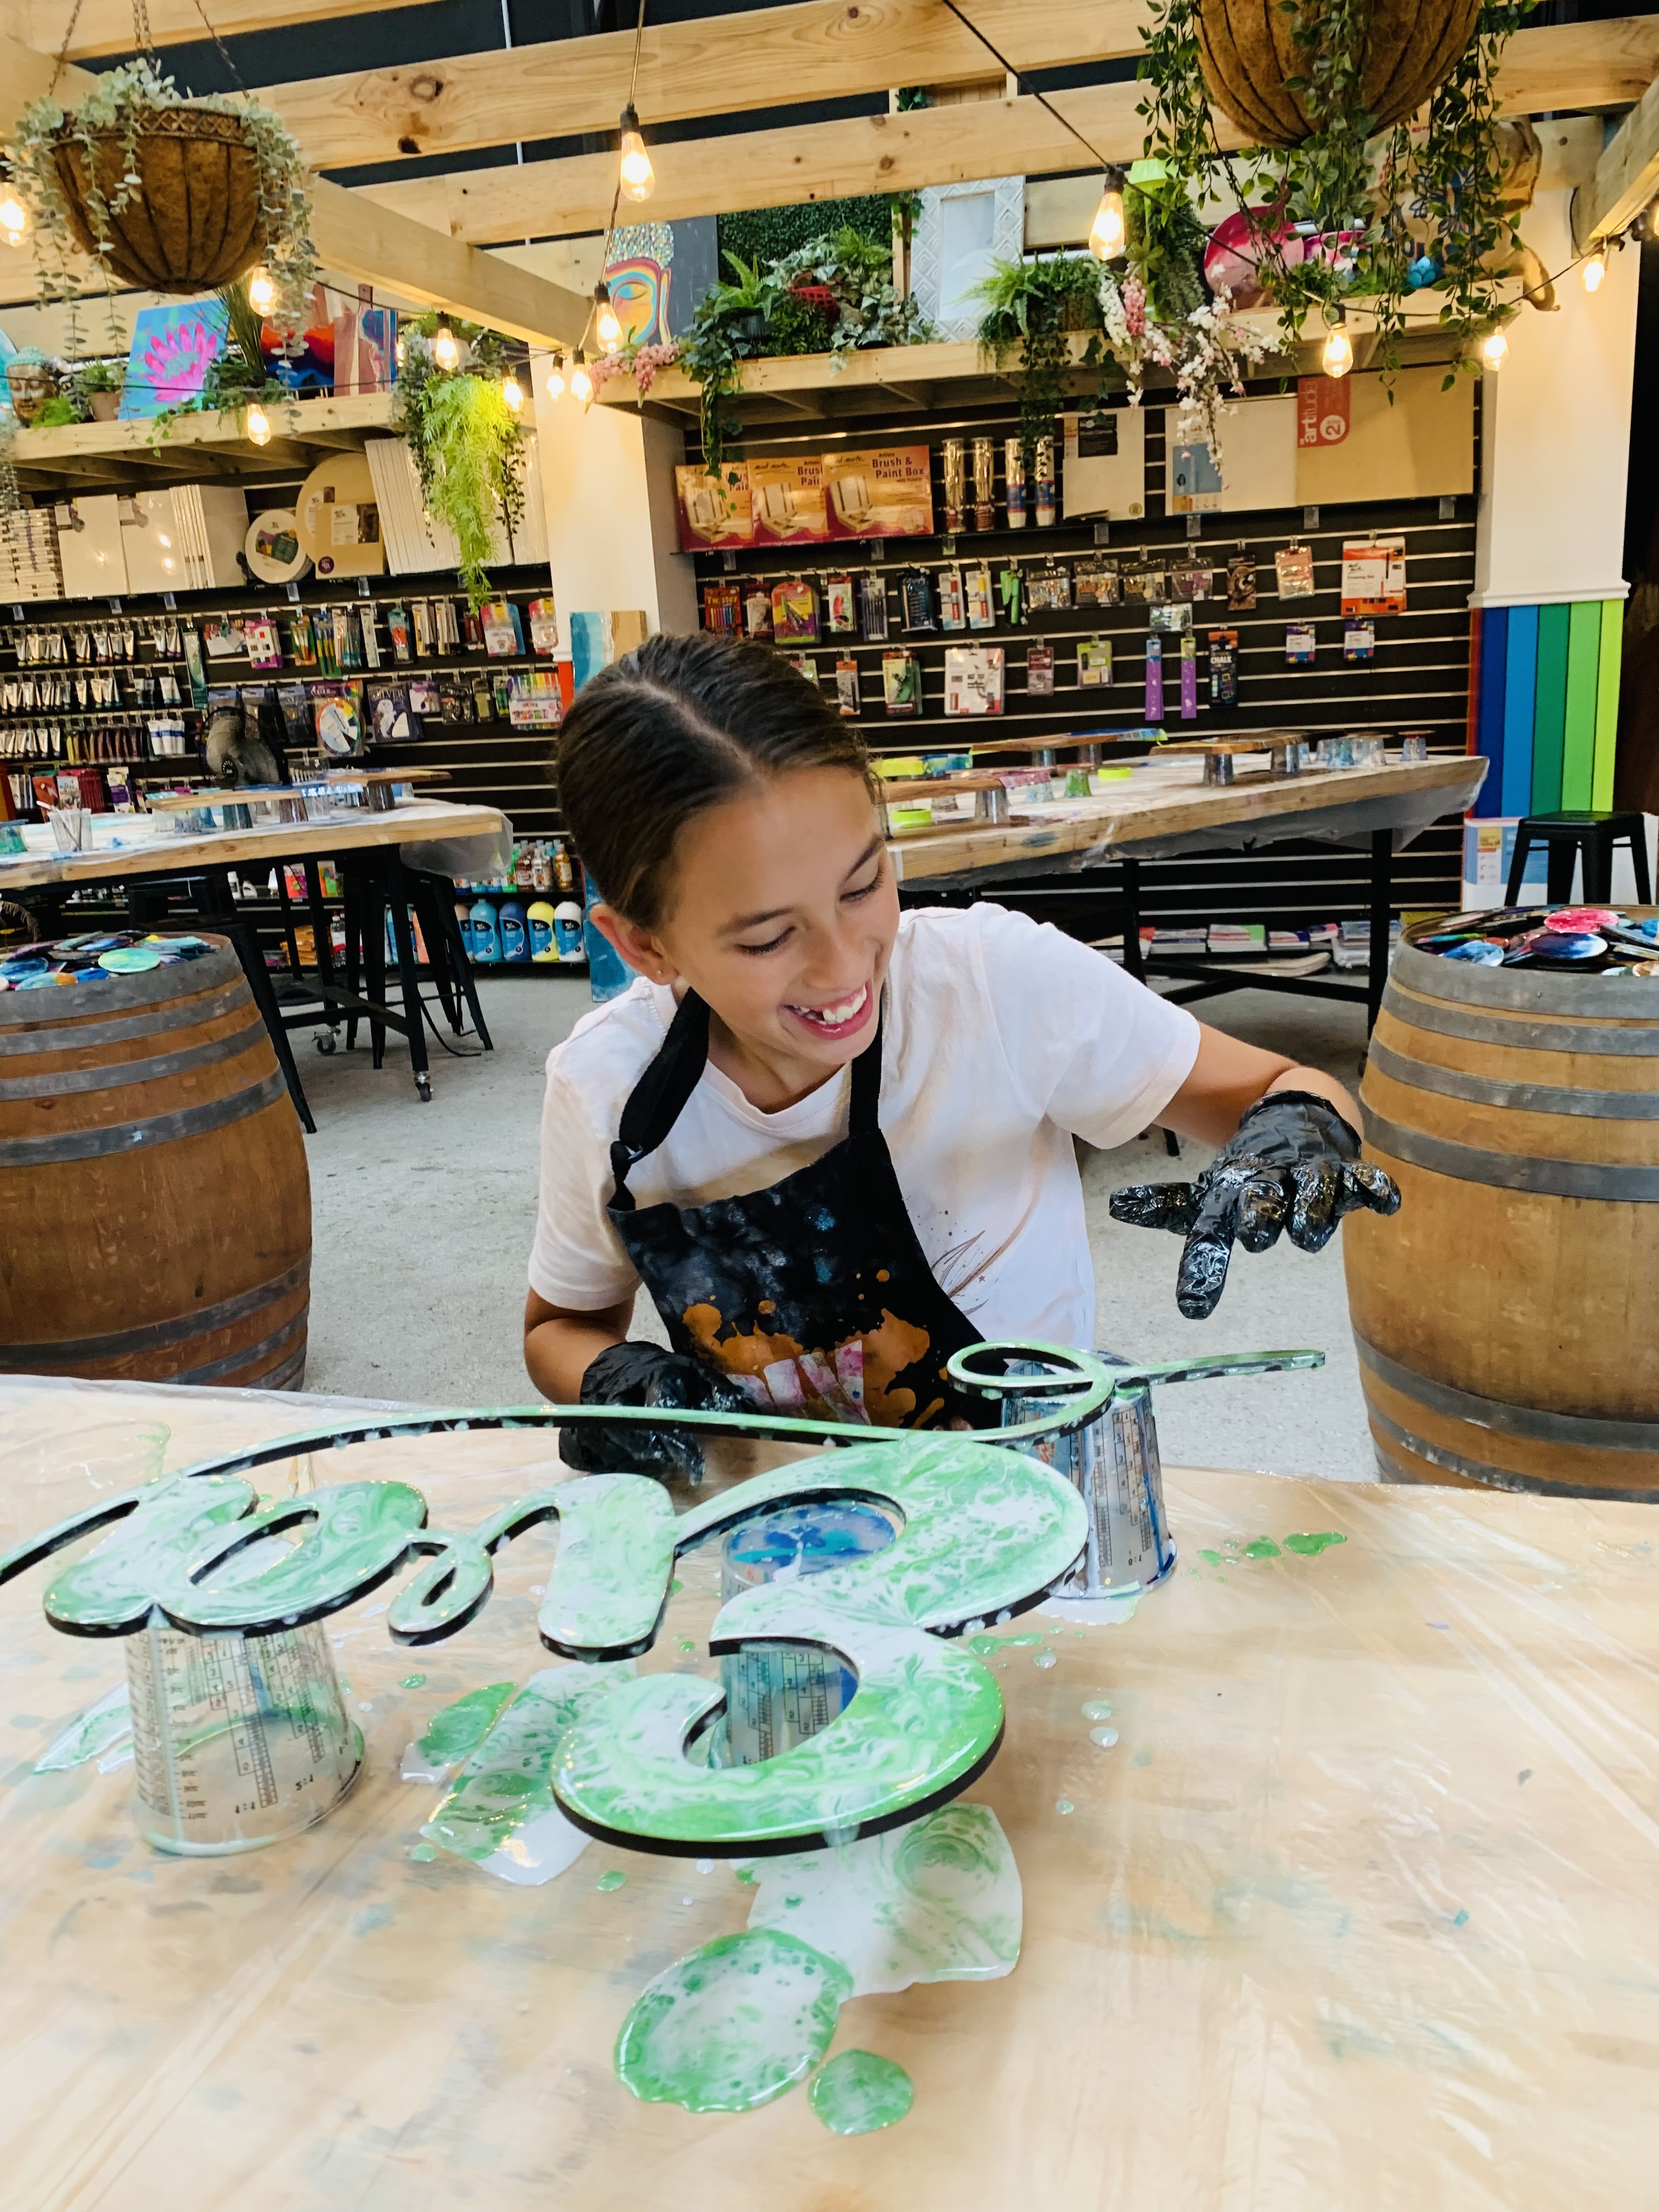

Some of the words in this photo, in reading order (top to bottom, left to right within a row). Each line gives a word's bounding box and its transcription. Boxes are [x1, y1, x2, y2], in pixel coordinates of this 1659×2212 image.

[872, 457, 901, 468] Brush
[905, 456, 912, 465] &
[876, 468, 902, 479] Paint
[906, 467, 924, 476] Box
